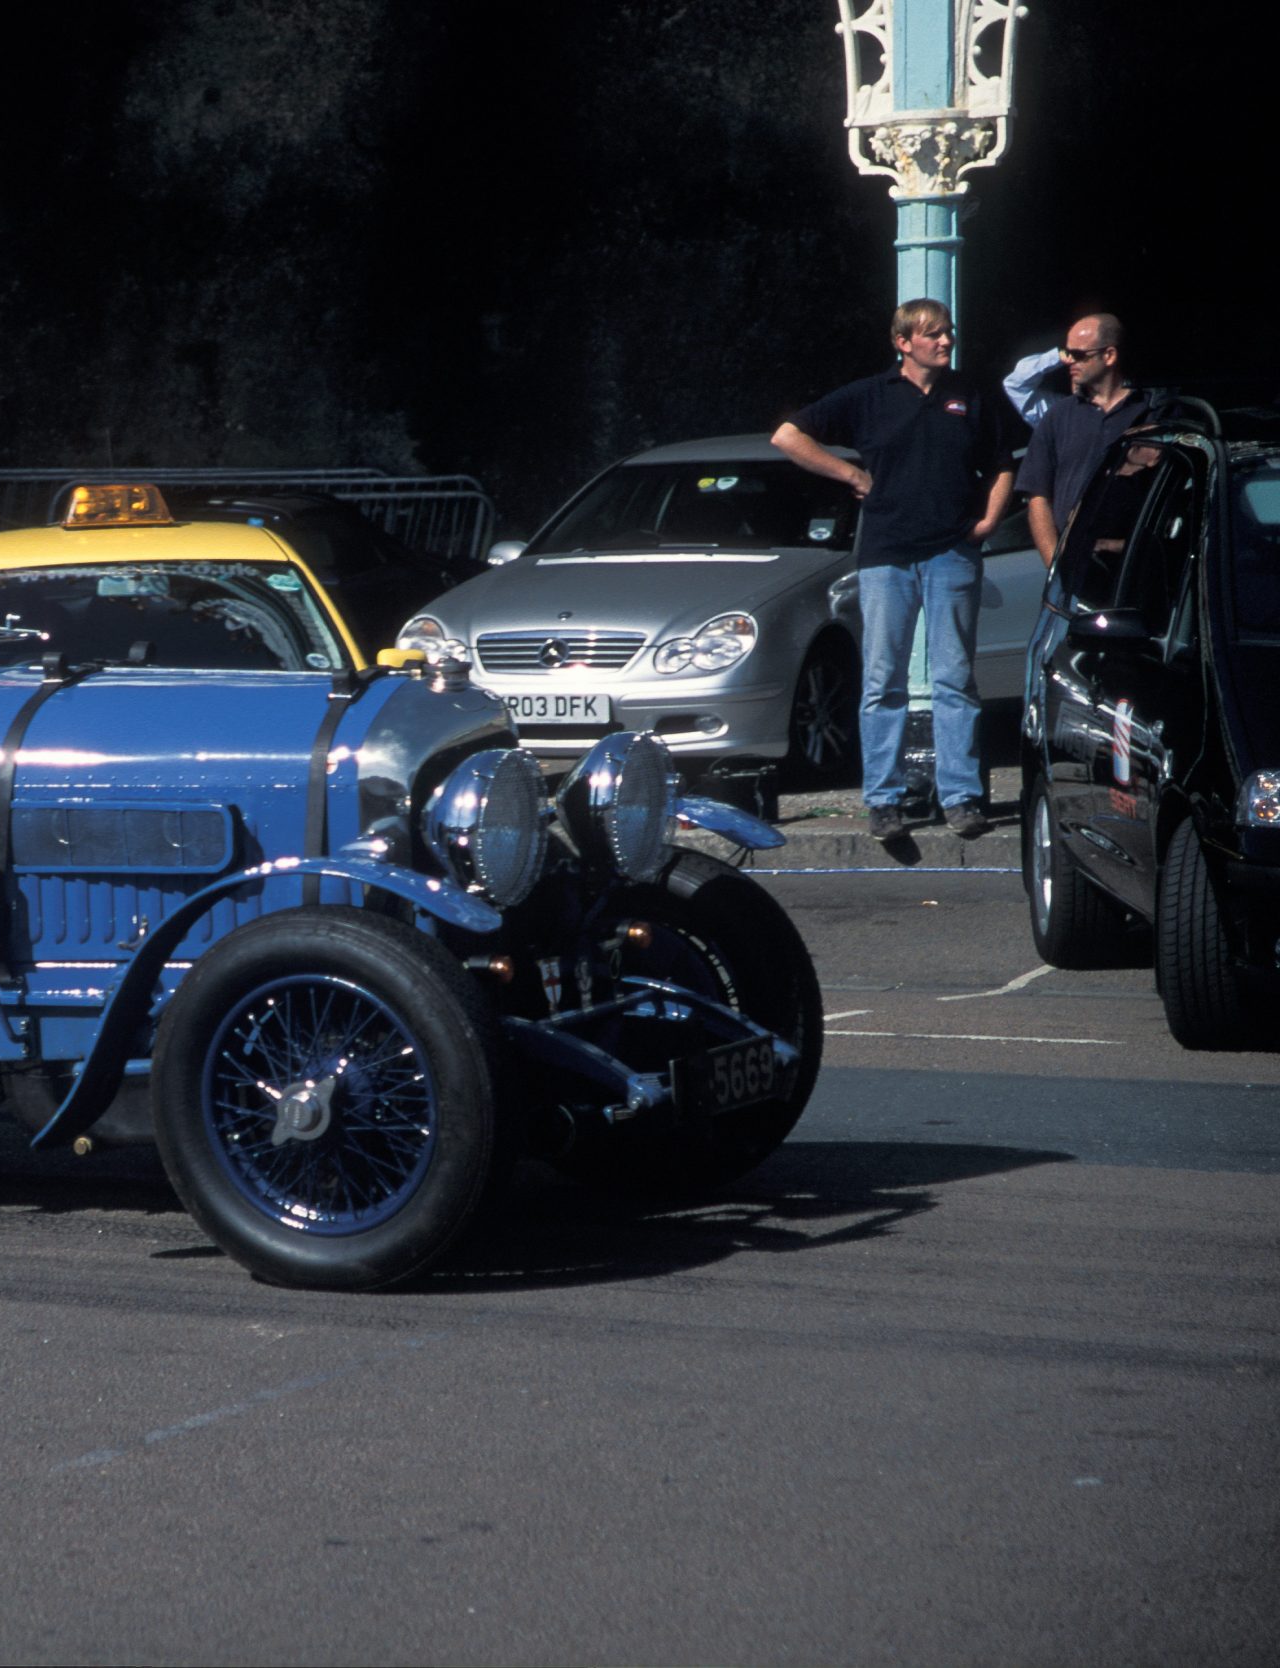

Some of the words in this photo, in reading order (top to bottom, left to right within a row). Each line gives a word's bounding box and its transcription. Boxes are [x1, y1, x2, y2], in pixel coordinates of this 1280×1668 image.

[505, 696, 548, 717] R03
[554, 696, 598, 717] DFK
[712, 1043, 774, 1105] 5669
